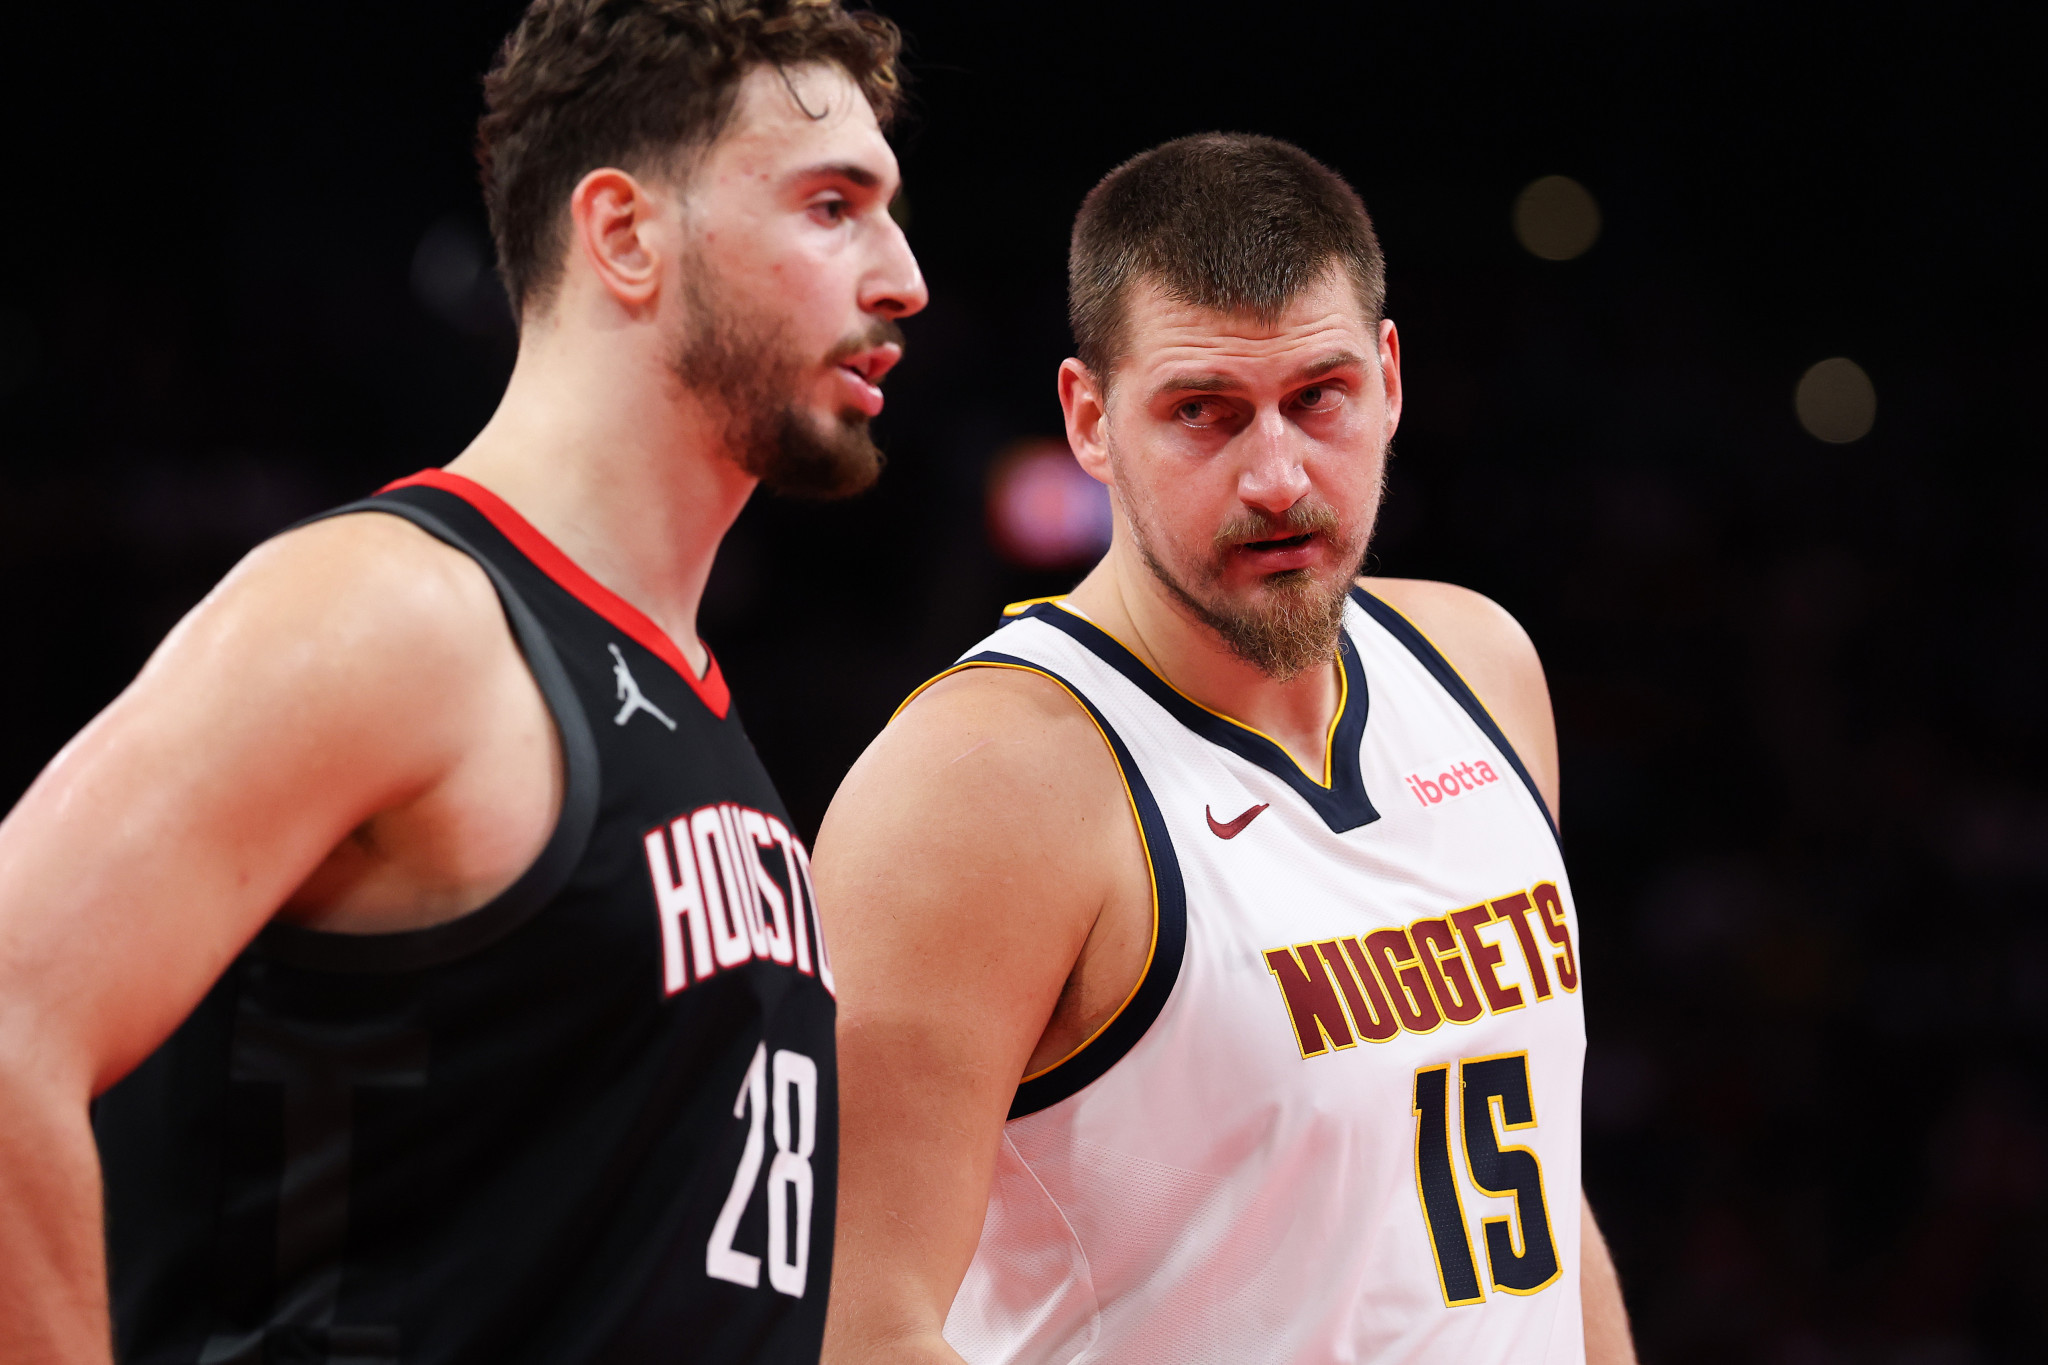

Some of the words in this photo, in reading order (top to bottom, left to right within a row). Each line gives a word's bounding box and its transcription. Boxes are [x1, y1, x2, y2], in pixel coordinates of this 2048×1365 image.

[1405, 760, 1498, 807] ibotta
[1262, 880, 1577, 1059] NUGGETS
[706, 1040, 817, 1298] 28
[1412, 1050, 1563, 1308] 15
